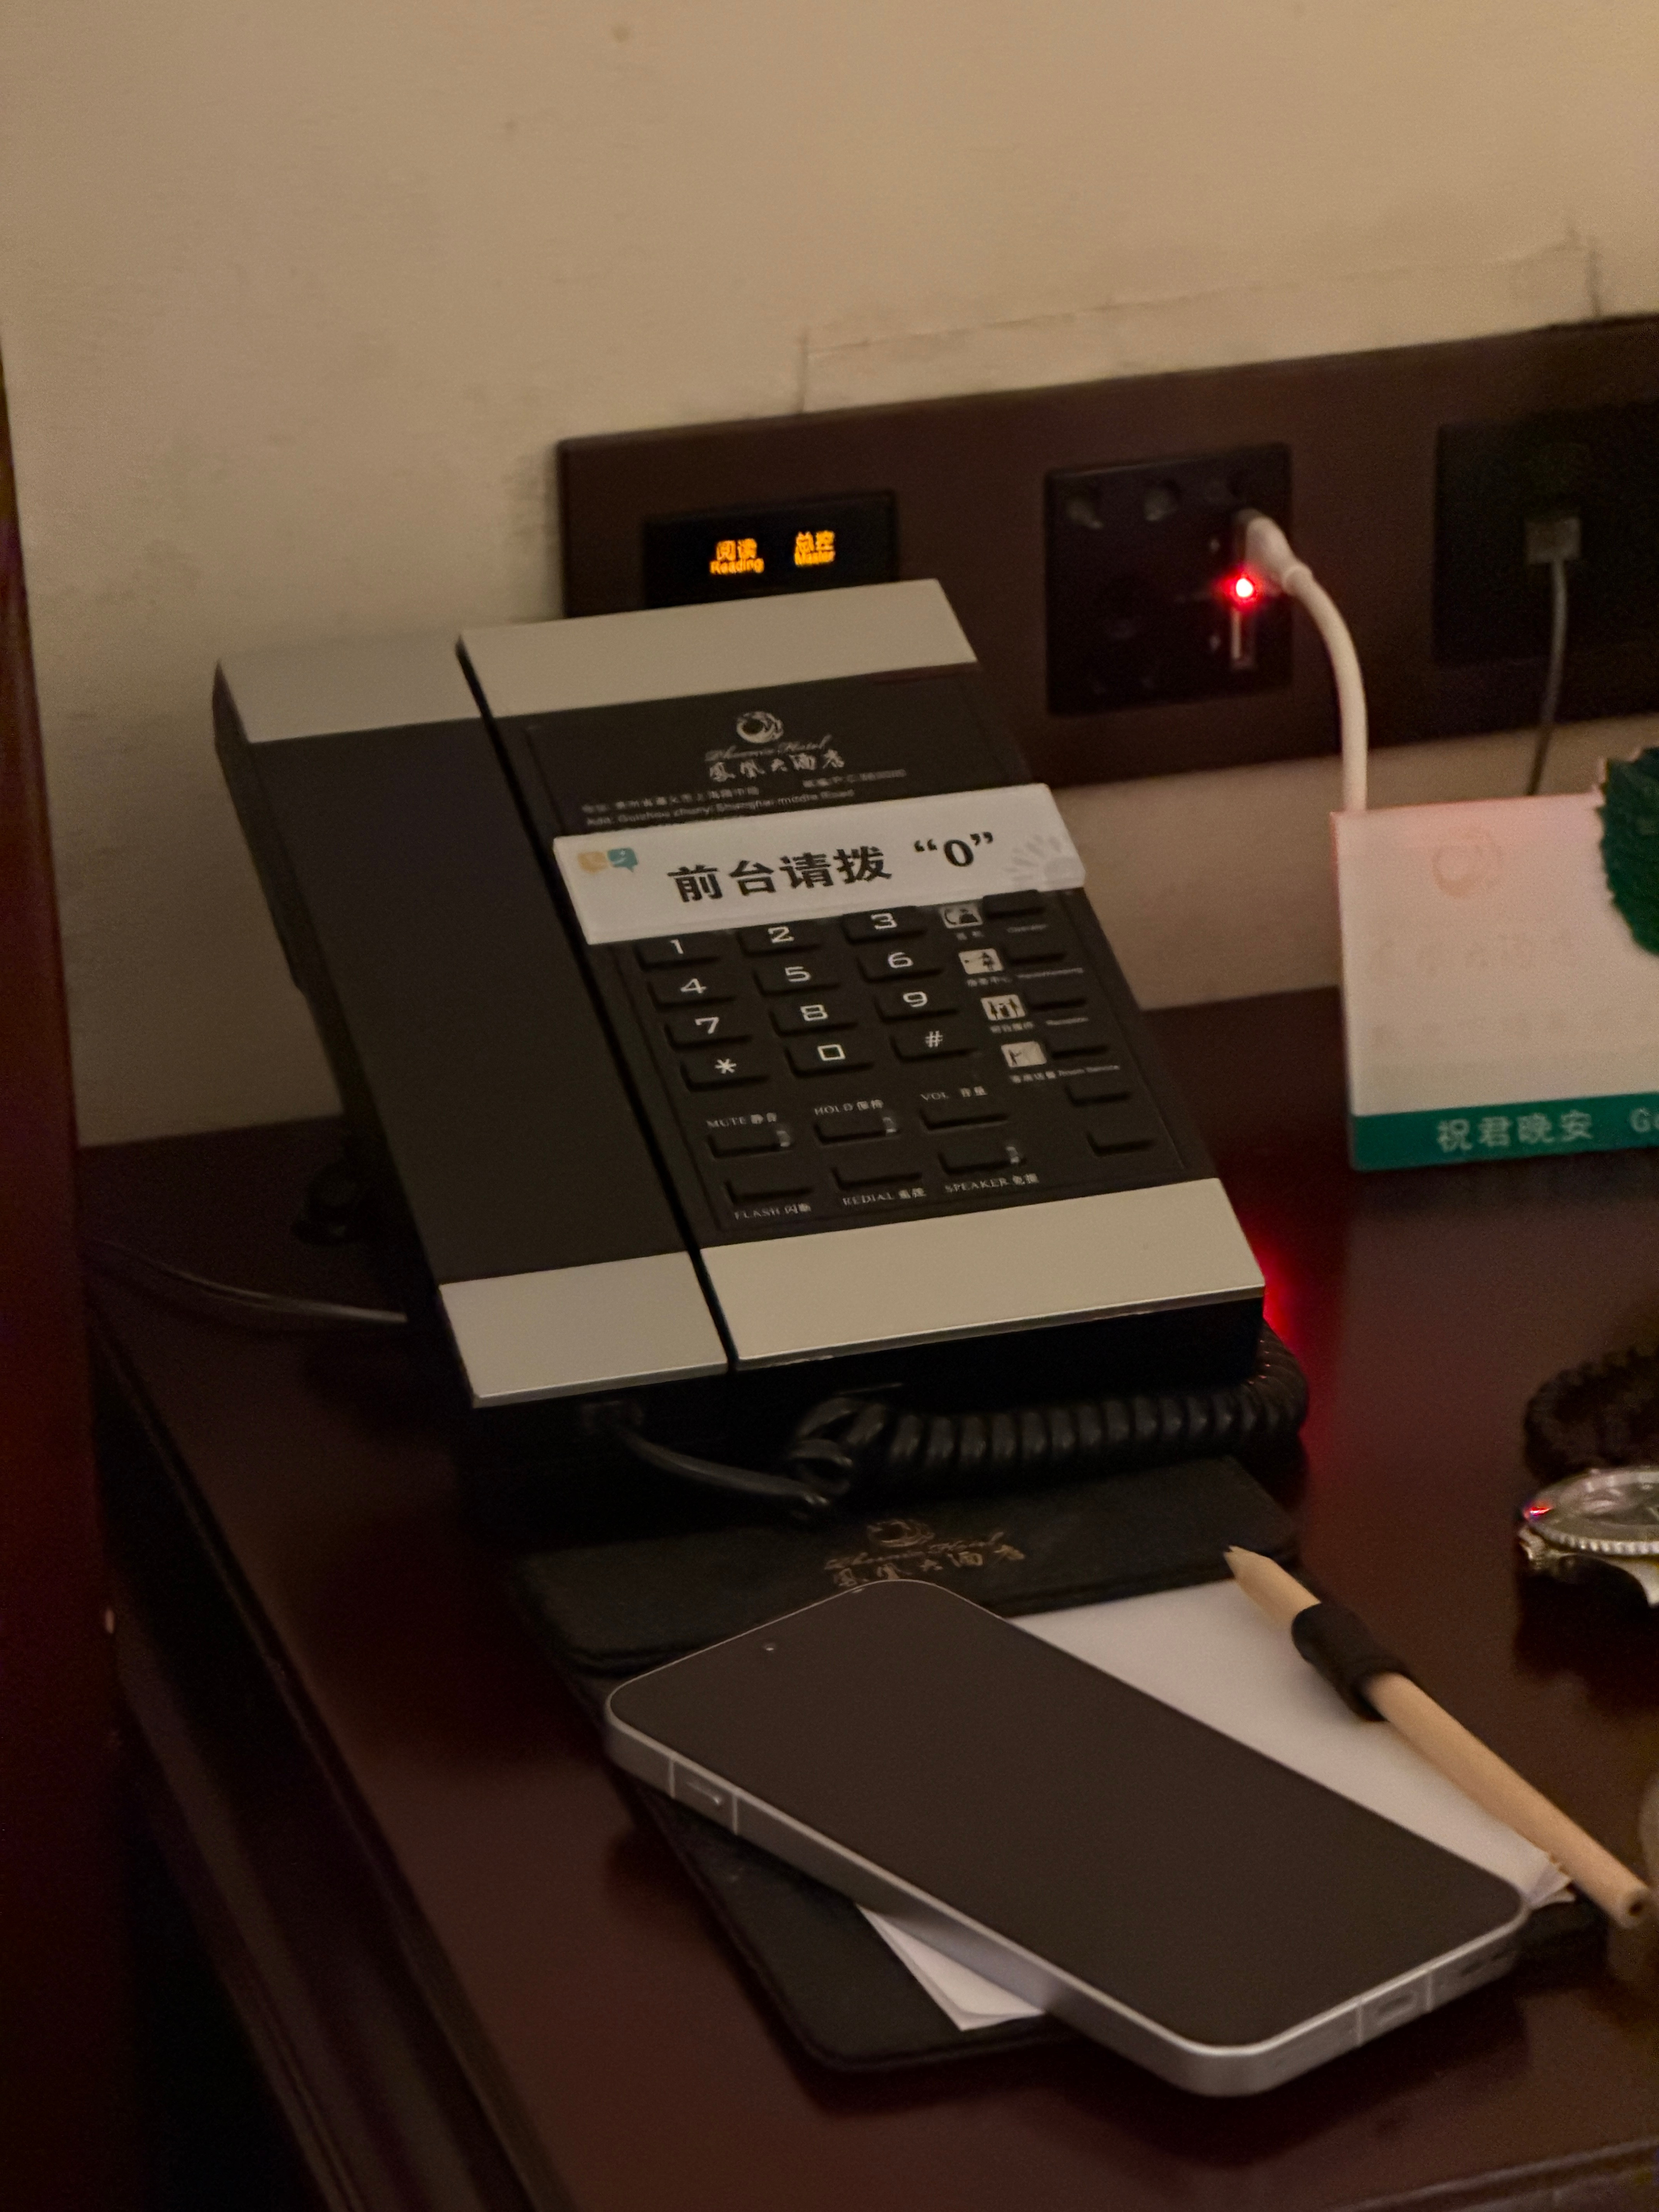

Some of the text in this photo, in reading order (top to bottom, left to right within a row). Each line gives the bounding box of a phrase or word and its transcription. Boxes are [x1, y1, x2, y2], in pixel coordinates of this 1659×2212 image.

[709, 557, 764, 575] Reading
[667, 847, 892, 903] 前台请拨
[670, 913, 898, 954] 1 2 3
[680, 951, 914, 994] 4 5 6
[695, 991, 928, 1034] 7 8 9
[921, 1092, 949, 1101] VOL
[814, 1103, 853, 1116] HOLD
[706, 1116, 746, 1128] MUTE
[1436, 1109, 1594, 1153] 祝君晚安
[945, 1177, 1010, 1194] SPEAKER
[842, 1192, 895, 1206] REDIAL
[734, 1207, 781, 1220] FLASH
